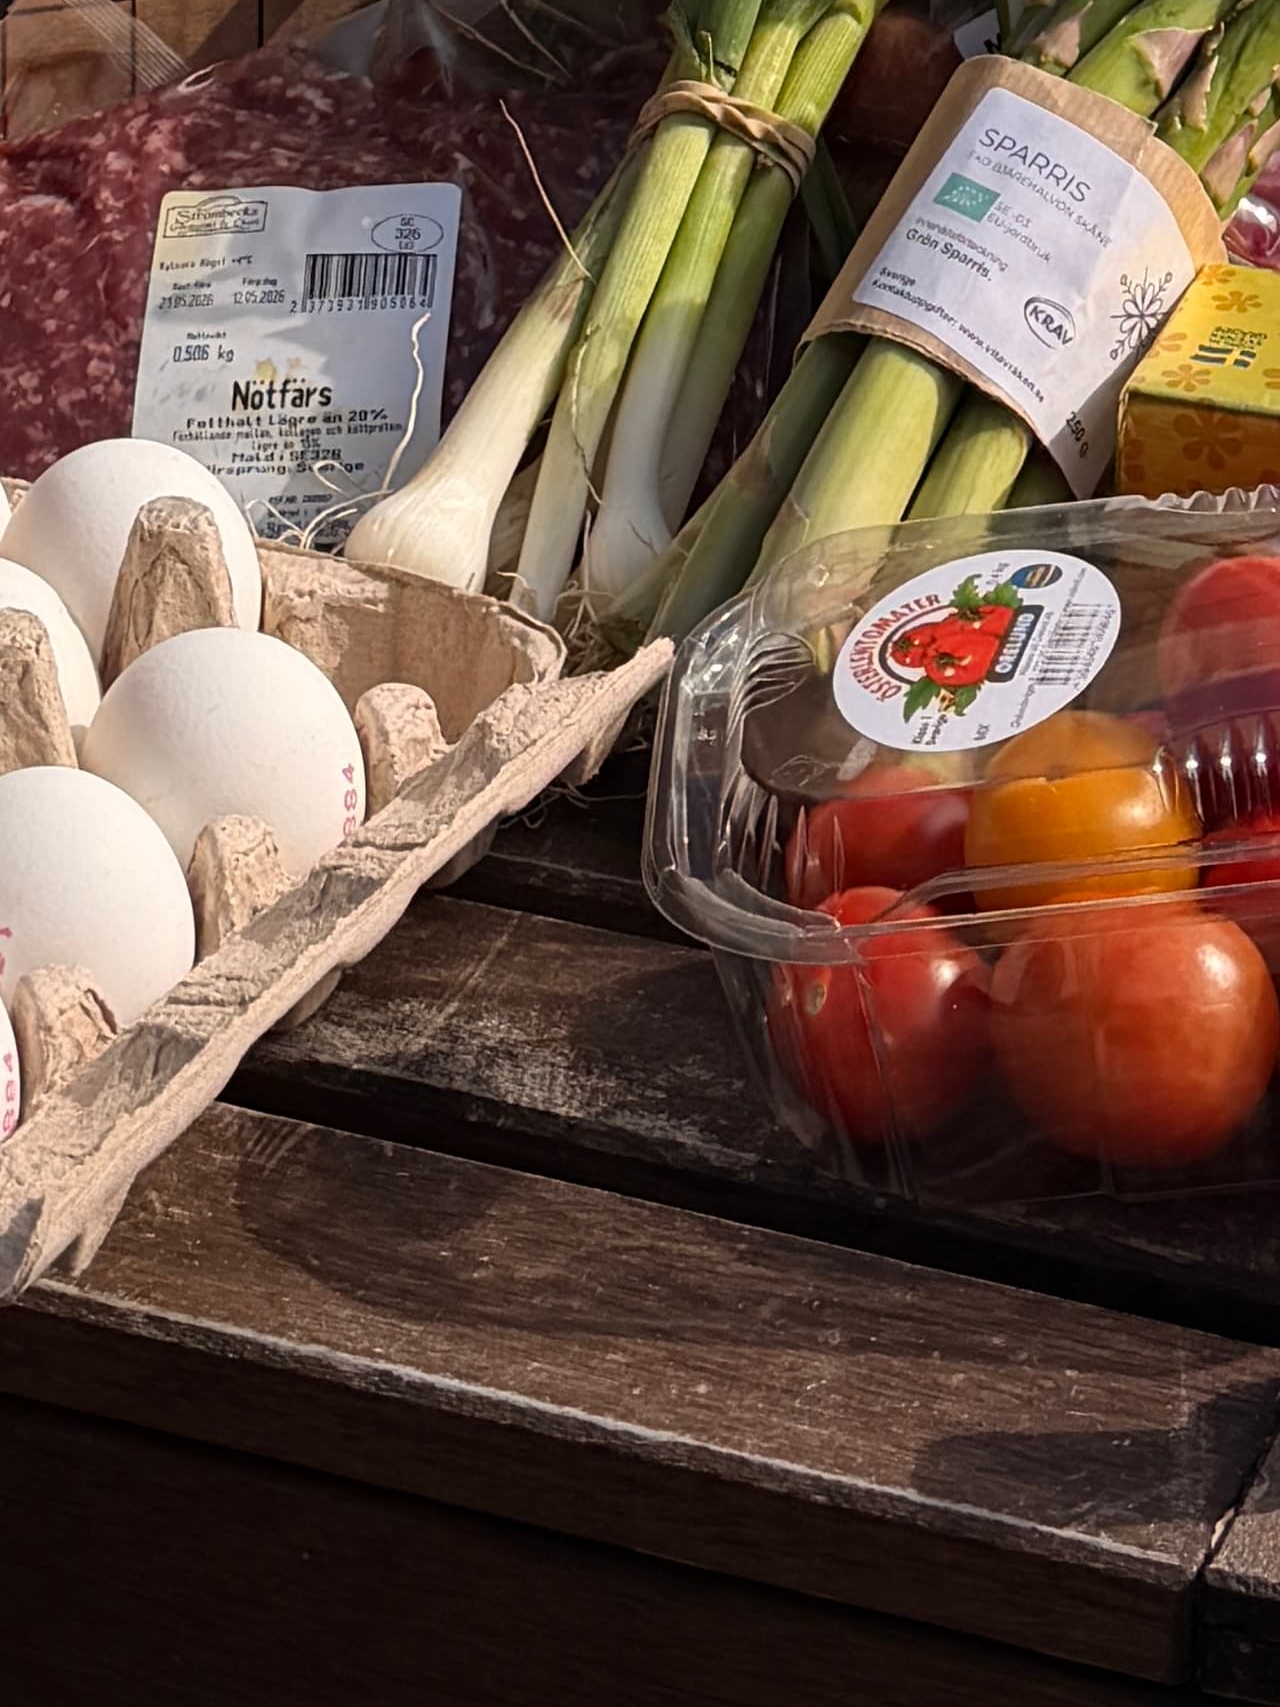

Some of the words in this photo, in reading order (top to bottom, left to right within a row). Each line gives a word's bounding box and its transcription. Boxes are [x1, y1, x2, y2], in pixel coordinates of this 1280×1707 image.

[978, 128, 1092, 203] SPARRIS
[906, 227, 939, 252] Grön
[939, 242, 993, 282] Sparris.
[1028, 303, 1074, 347] KRAV
[217, 346, 235, 364] kg
[231, 378, 333, 412] Nötfärs
[348, 408, 389, 424] 20%
[1065, 410, 1088, 442] 250
